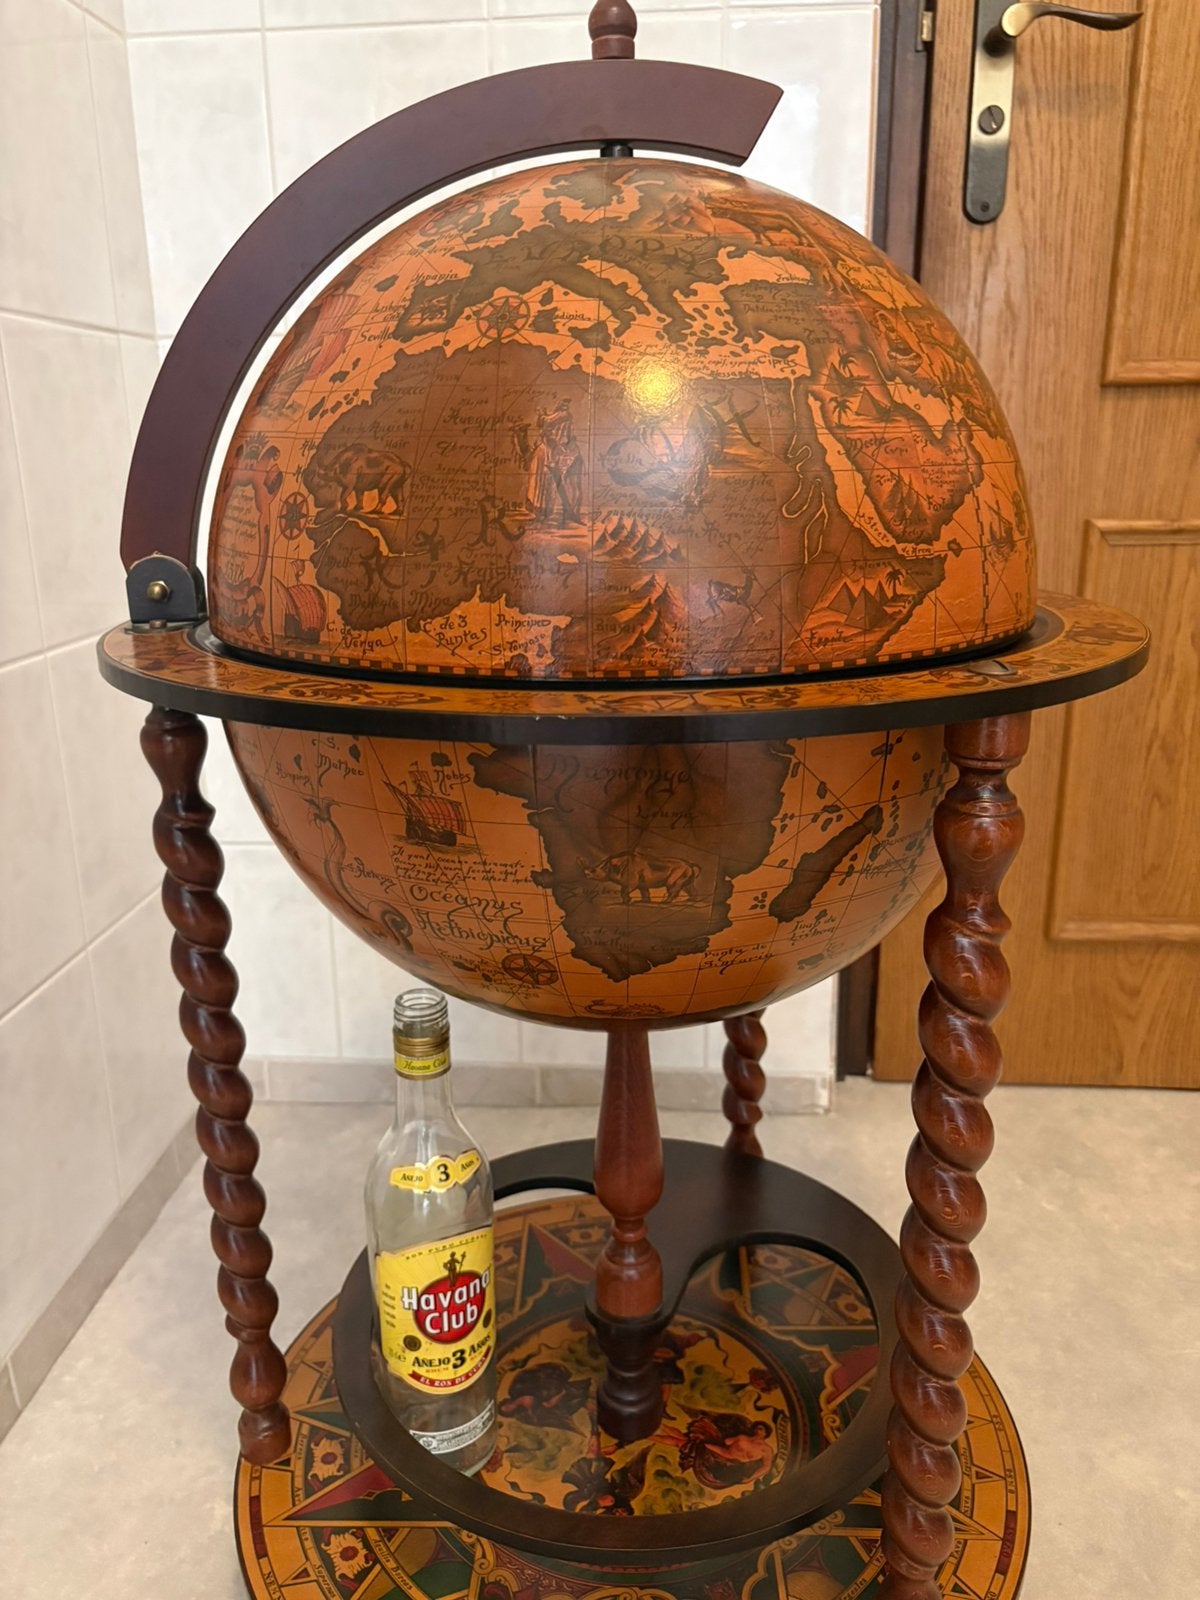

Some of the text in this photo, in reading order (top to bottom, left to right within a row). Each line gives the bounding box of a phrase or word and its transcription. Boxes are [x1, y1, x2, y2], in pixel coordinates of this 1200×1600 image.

[436, 1163, 450, 1182] 3
[402, 1270, 489, 1311] Havana
[424, 1303, 479, 1334] Club
[452, 1348, 466, 1370] 3
